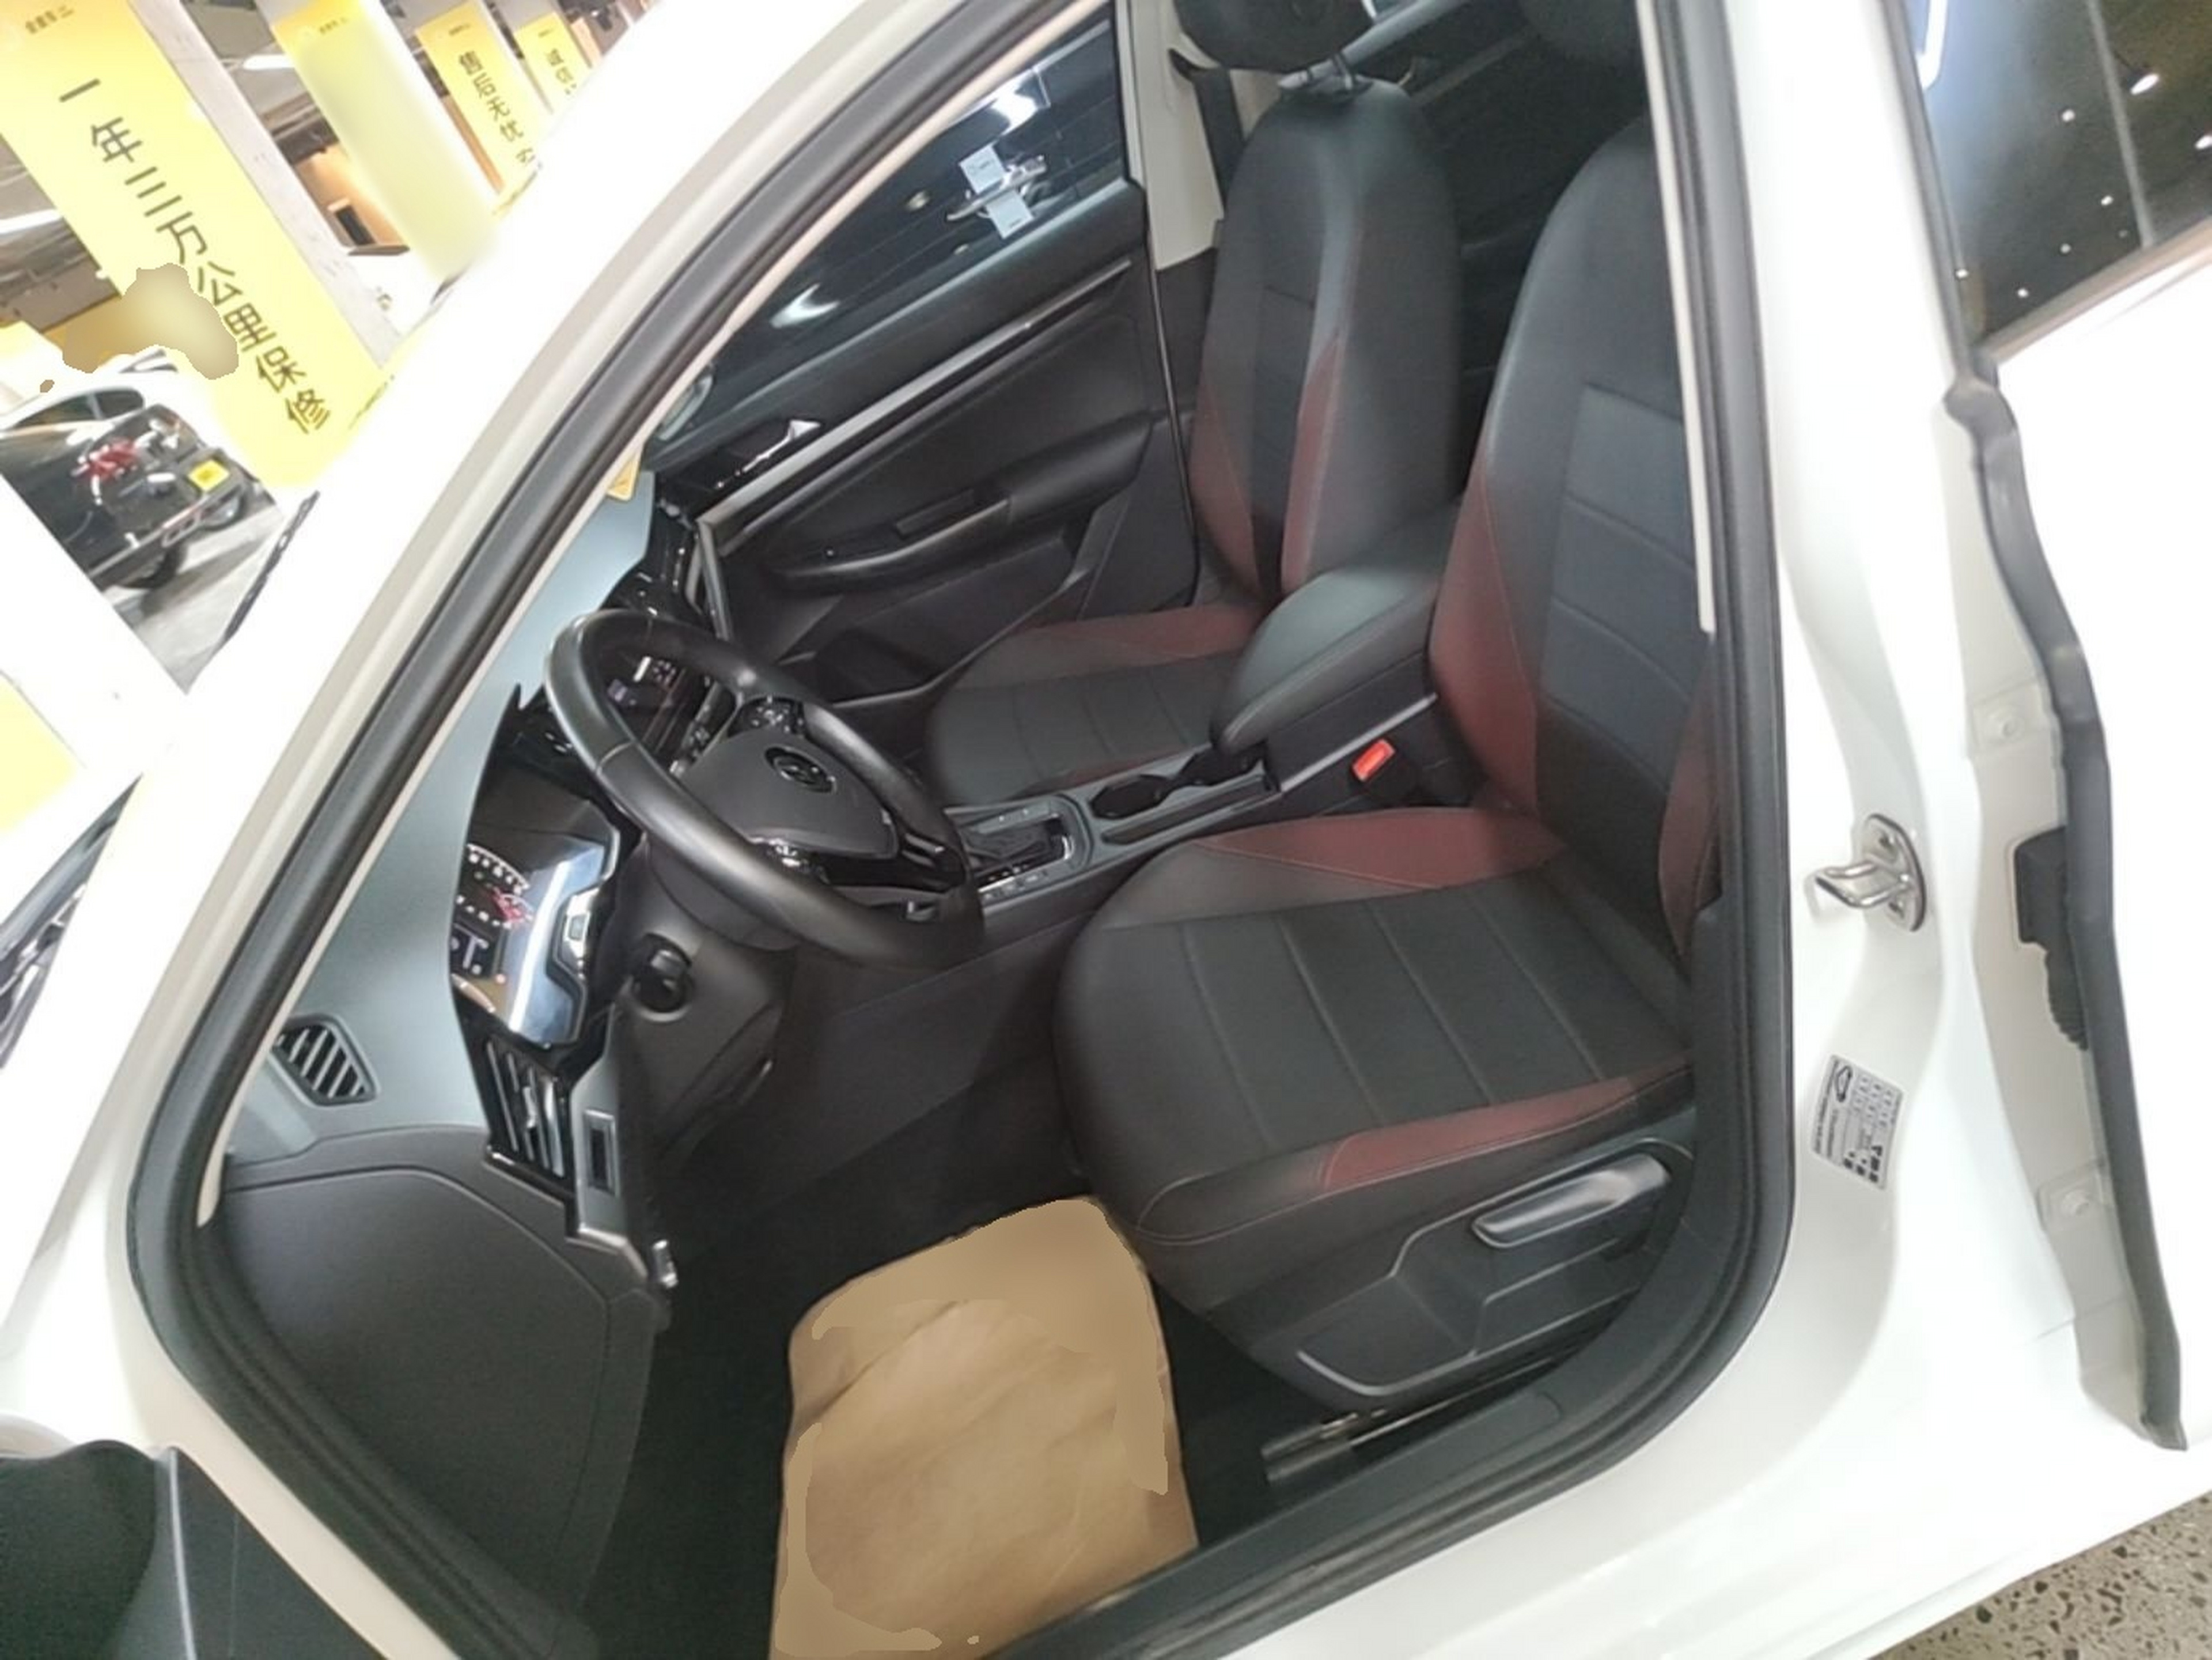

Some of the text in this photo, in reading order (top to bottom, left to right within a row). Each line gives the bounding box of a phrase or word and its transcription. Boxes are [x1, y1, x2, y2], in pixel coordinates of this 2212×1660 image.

[59, 78, 331, 434] 一年三万公里保修
